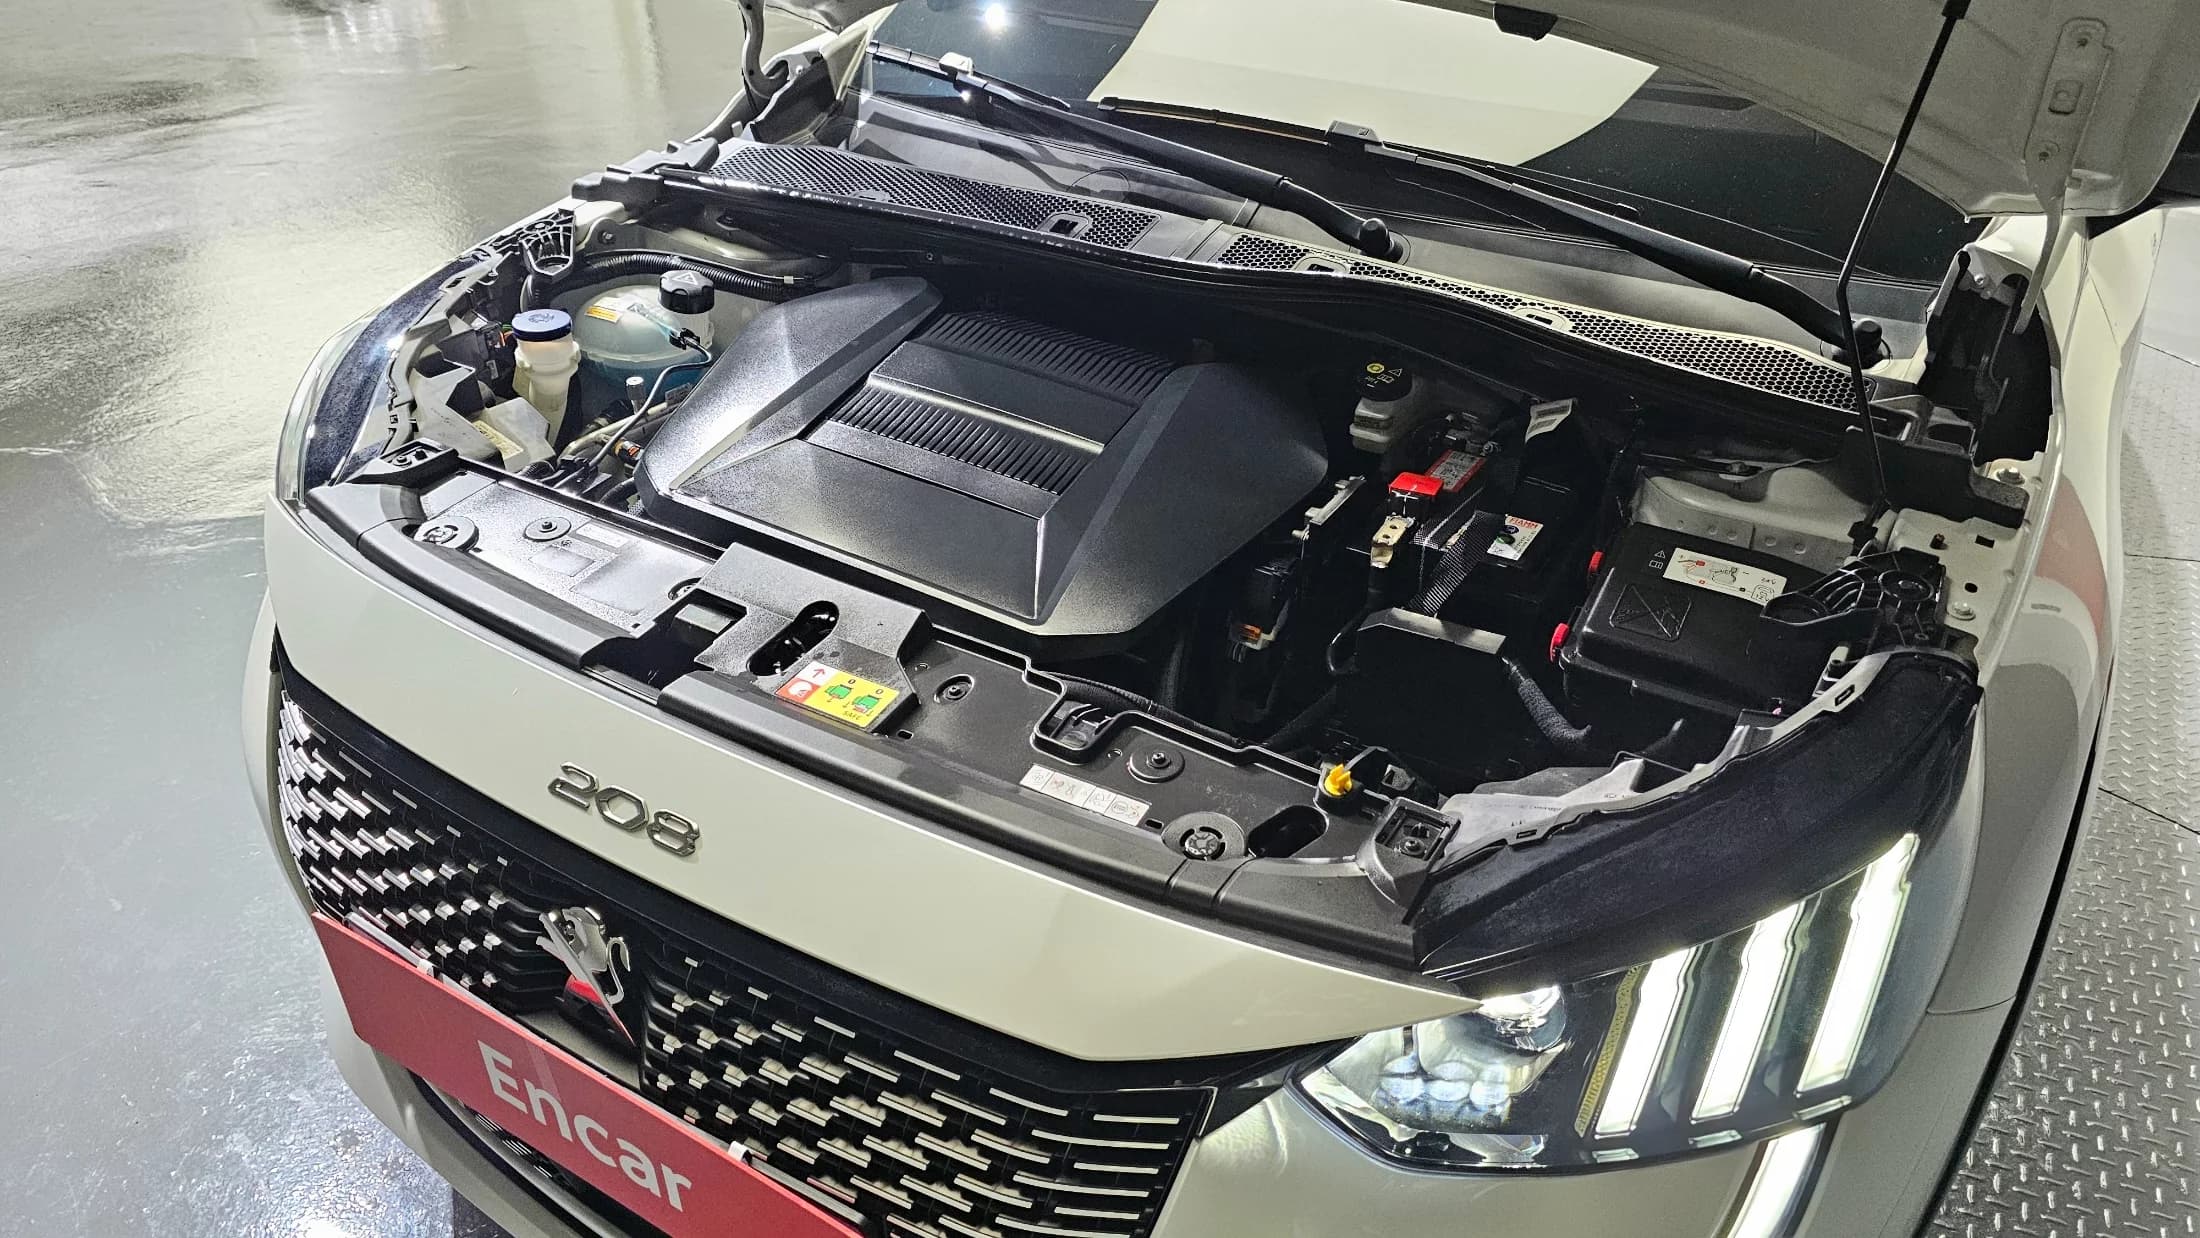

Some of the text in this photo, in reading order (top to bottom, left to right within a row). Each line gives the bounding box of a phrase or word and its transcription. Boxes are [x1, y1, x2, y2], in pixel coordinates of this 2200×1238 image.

[1509, 517, 1538, 529] FIAMM
[547, 761, 701, 858] 208
[477, 1040, 692, 1213] Encar
